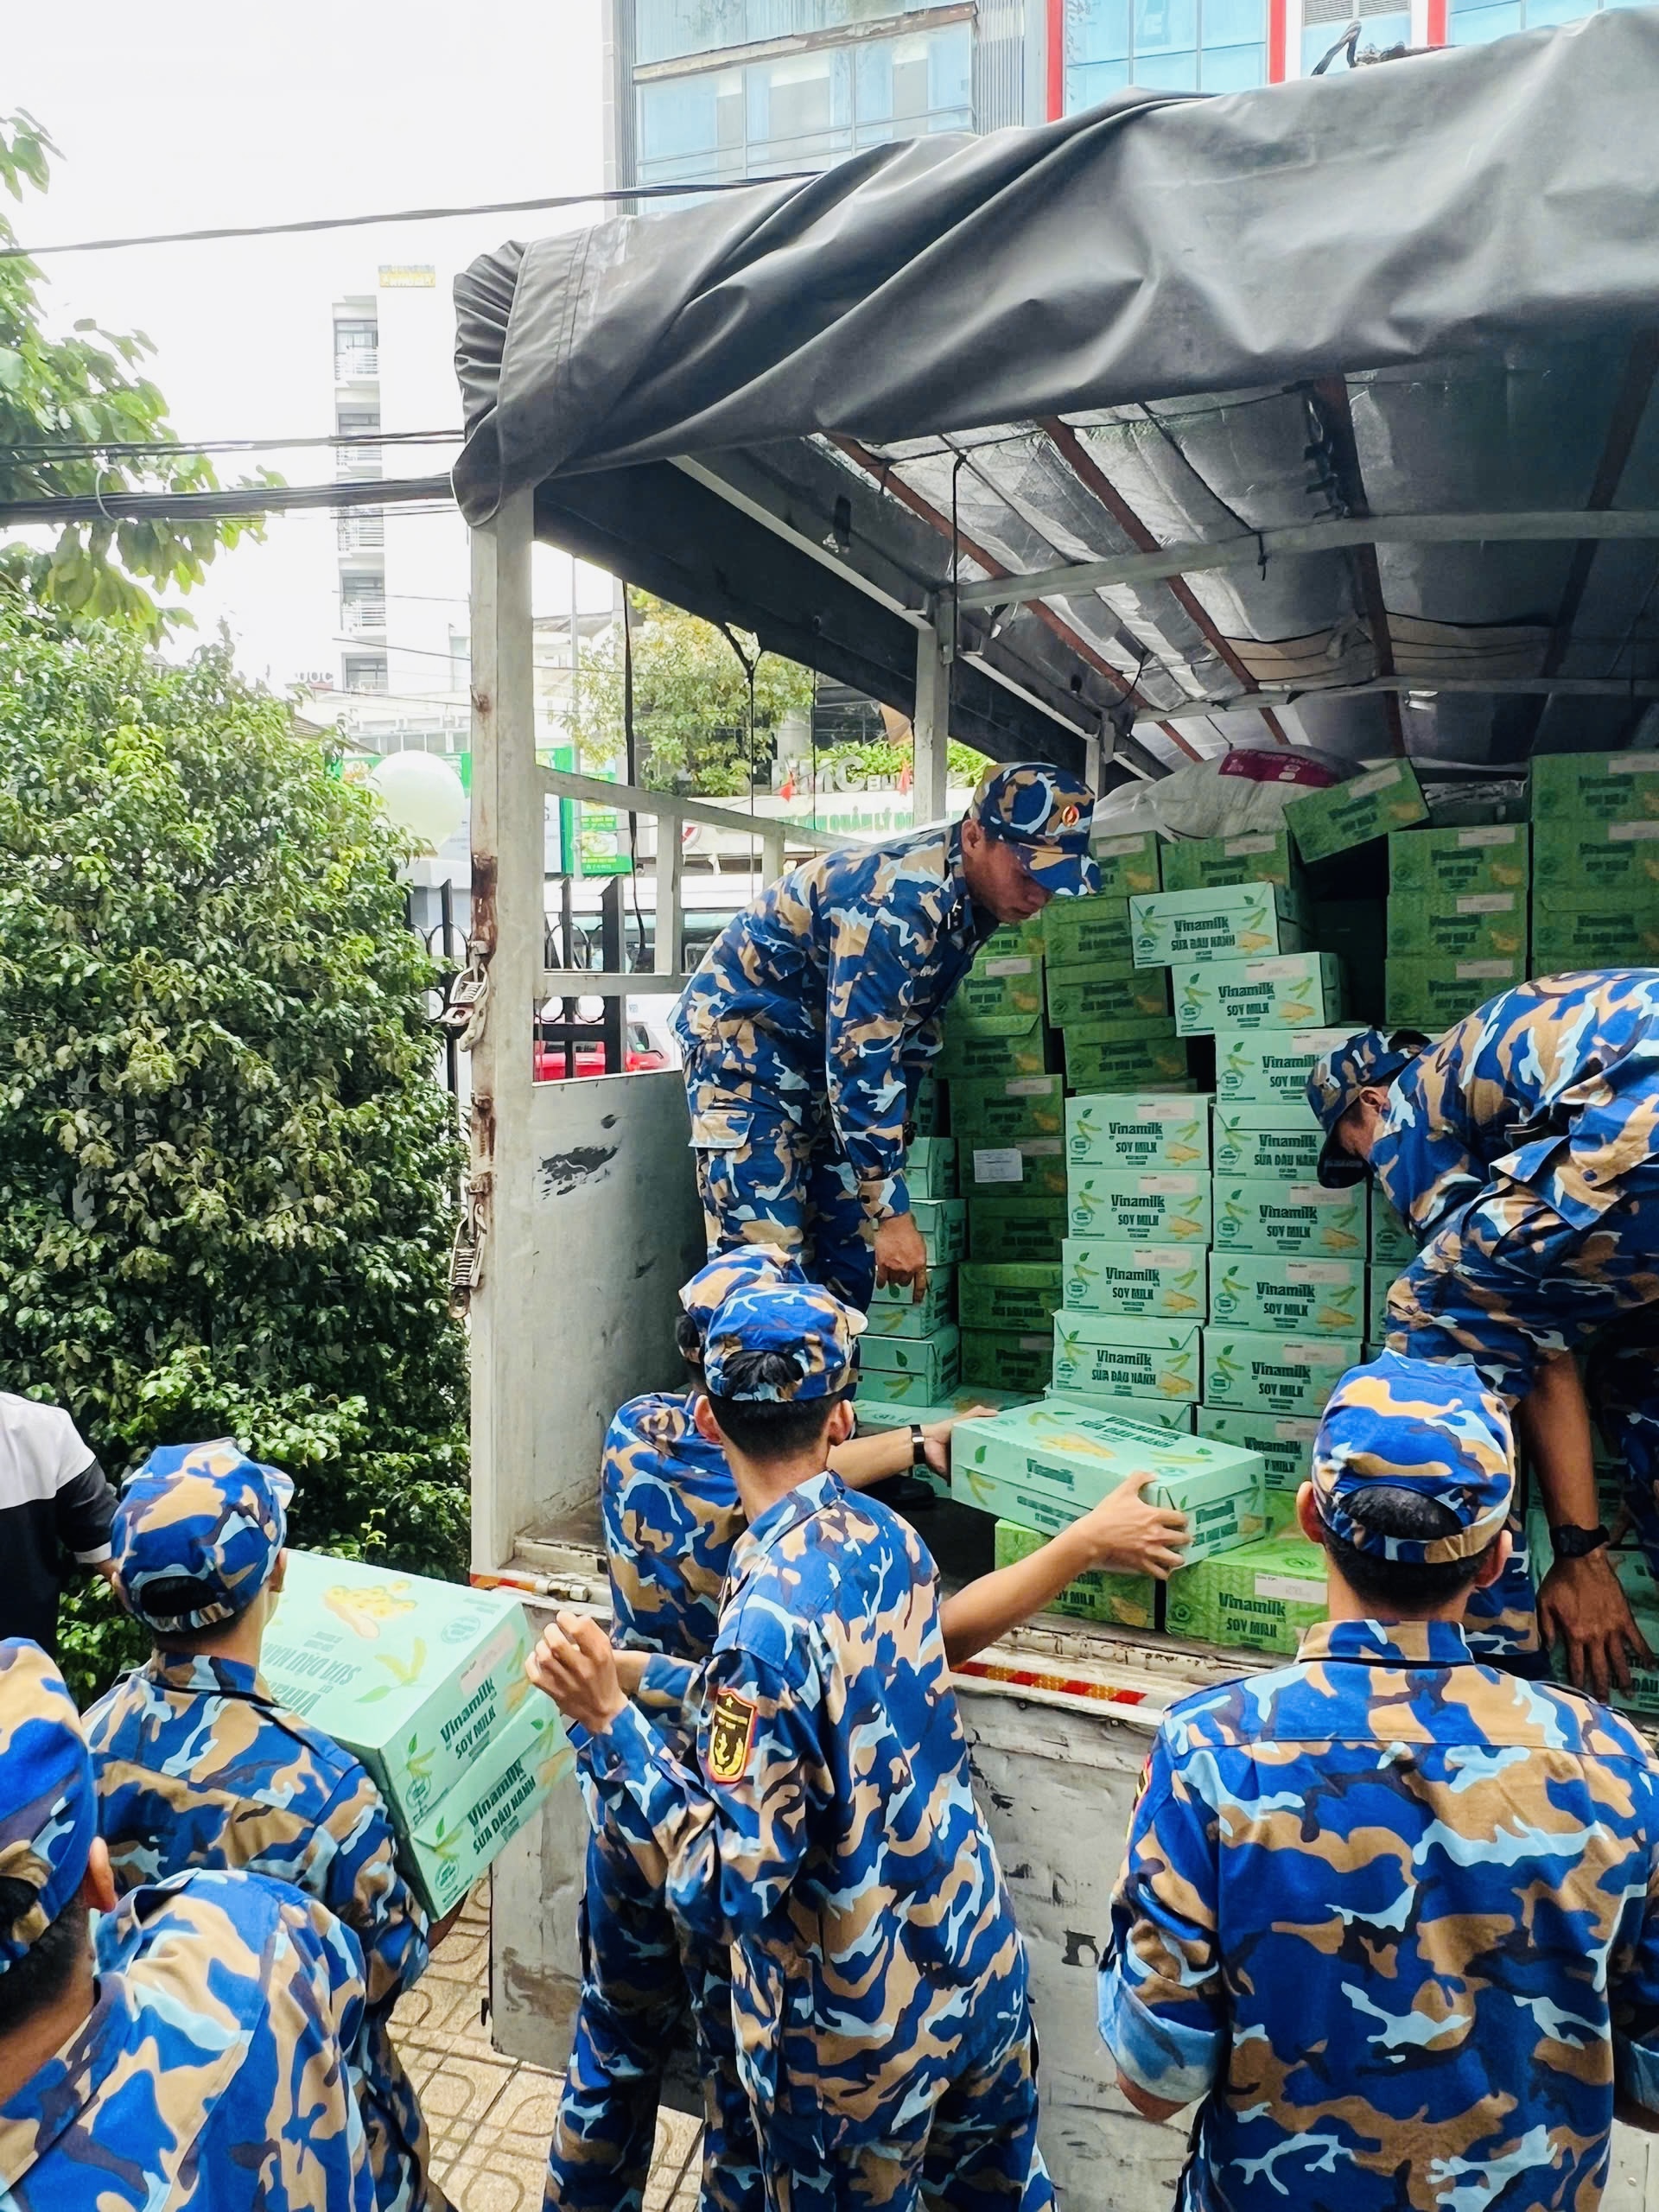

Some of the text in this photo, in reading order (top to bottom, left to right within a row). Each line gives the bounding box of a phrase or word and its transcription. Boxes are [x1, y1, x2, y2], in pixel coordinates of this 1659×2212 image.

[1218, 982, 1274, 998] Vinamilk
[1227, 1005, 1244, 1016] SOY
[1270, 1077, 1287, 1087] SOY
[1109, 1122, 1163, 1135] Vinamilk
[1116, 1141, 1158, 1153] SOY MILK
[1259, 1135, 1317, 1147] Vinamilk
[1110, 1194, 1166, 1208] Vinamilk
[1259, 1205, 1318, 1219] Vinamilk
[1118, 1214, 1159, 1226] SOY MILK
[1267, 1225, 1311, 1238] SOY MILK
[1106, 1267, 1160, 1281] Vinamilk
[1112, 1287, 1154, 1300] SOY MILK
[1256, 1281, 1315, 1297] Vinamilk
[1264, 1303, 1308, 1317] SOY MILK
[1096, 1350, 1152, 1366] Vinamilk
[1251, 1362, 1311, 1378] Vinamilk
[1258, 1382, 1304, 1397] SOY MILK
[1219, 1592, 1286, 1617] Vinamilk
[1227, 1618, 1247, 1632] SOY
[440, 1677, 496, 1744] Vinamilk
[455, 1705, 496, 1760] SOY MILK
[467, 1758, 525, 1827] Vinamilk
